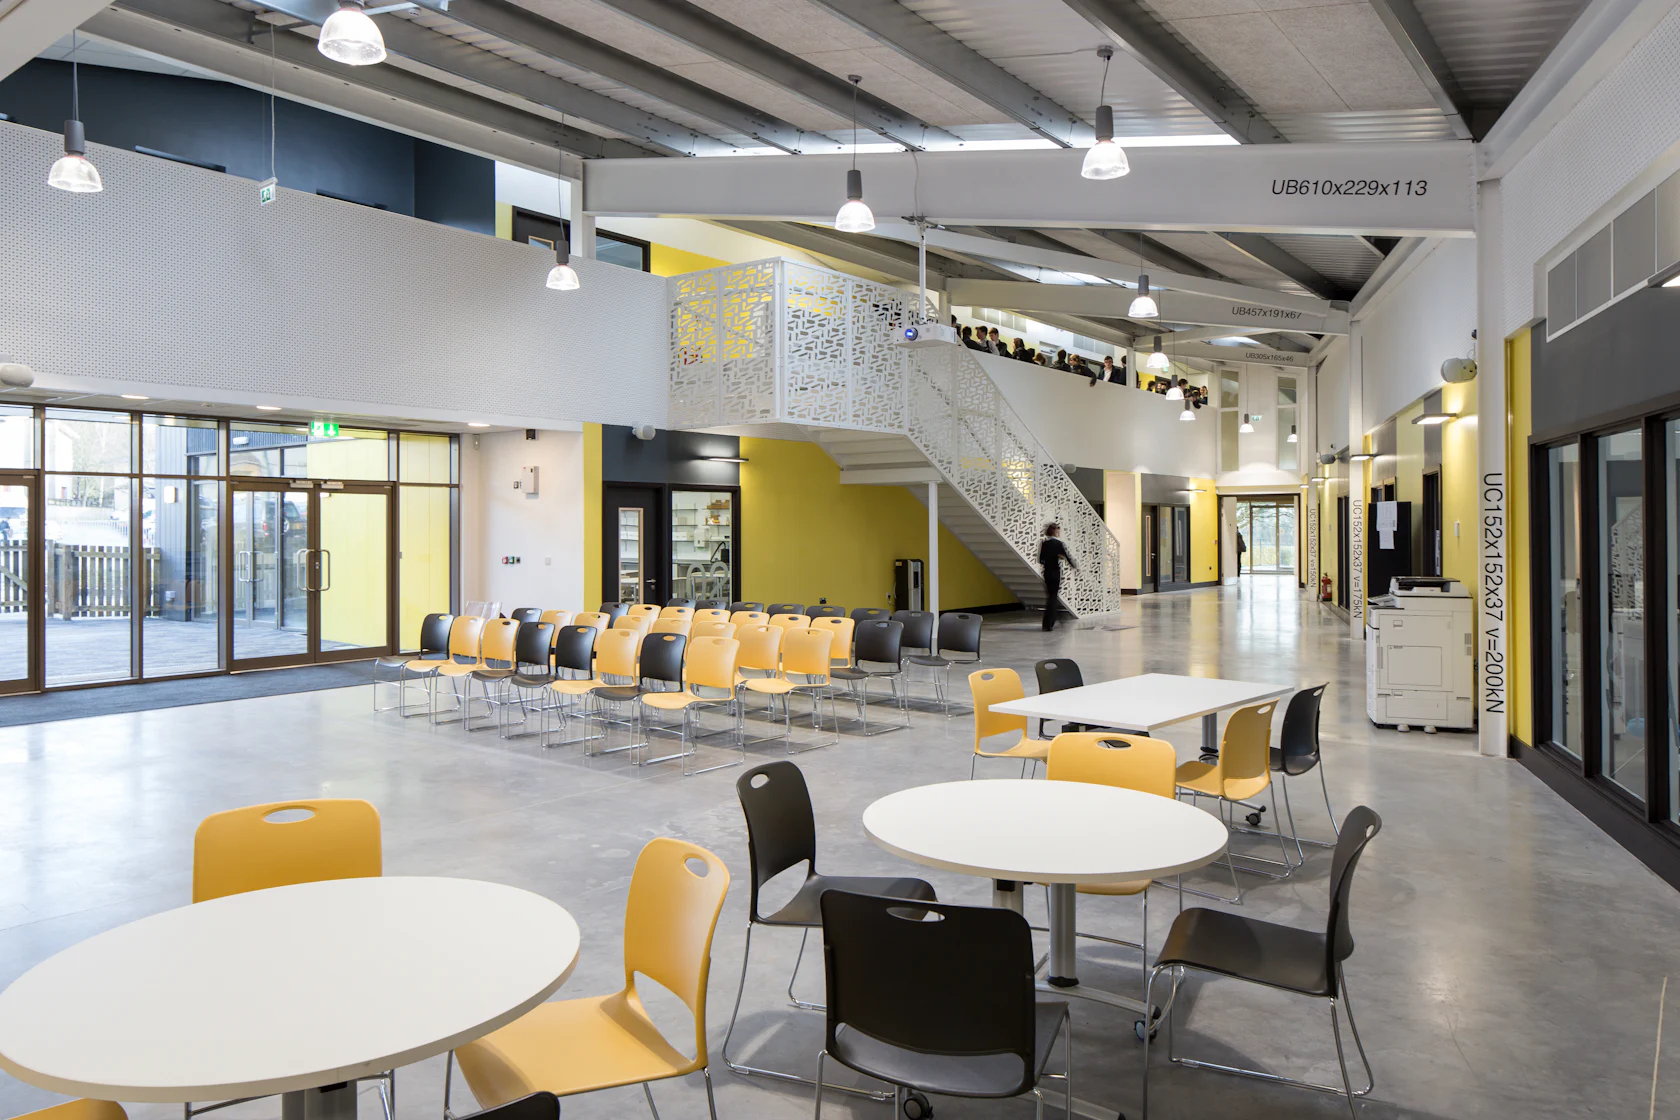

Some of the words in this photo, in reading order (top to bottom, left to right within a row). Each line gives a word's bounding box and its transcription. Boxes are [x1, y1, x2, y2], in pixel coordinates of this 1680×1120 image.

[1271, 179, 1428, 196] UB610x229x113
[1231, 306, 1302, 320] UB457x191x67
[1353, 499, 1363, 573] UC152x152x37
[1484, 473, 1504, 621] UC152x152x37
[1353, 576, 1363, 619] v=175kN
[1485, 628, 1504, 714] v=200kN
